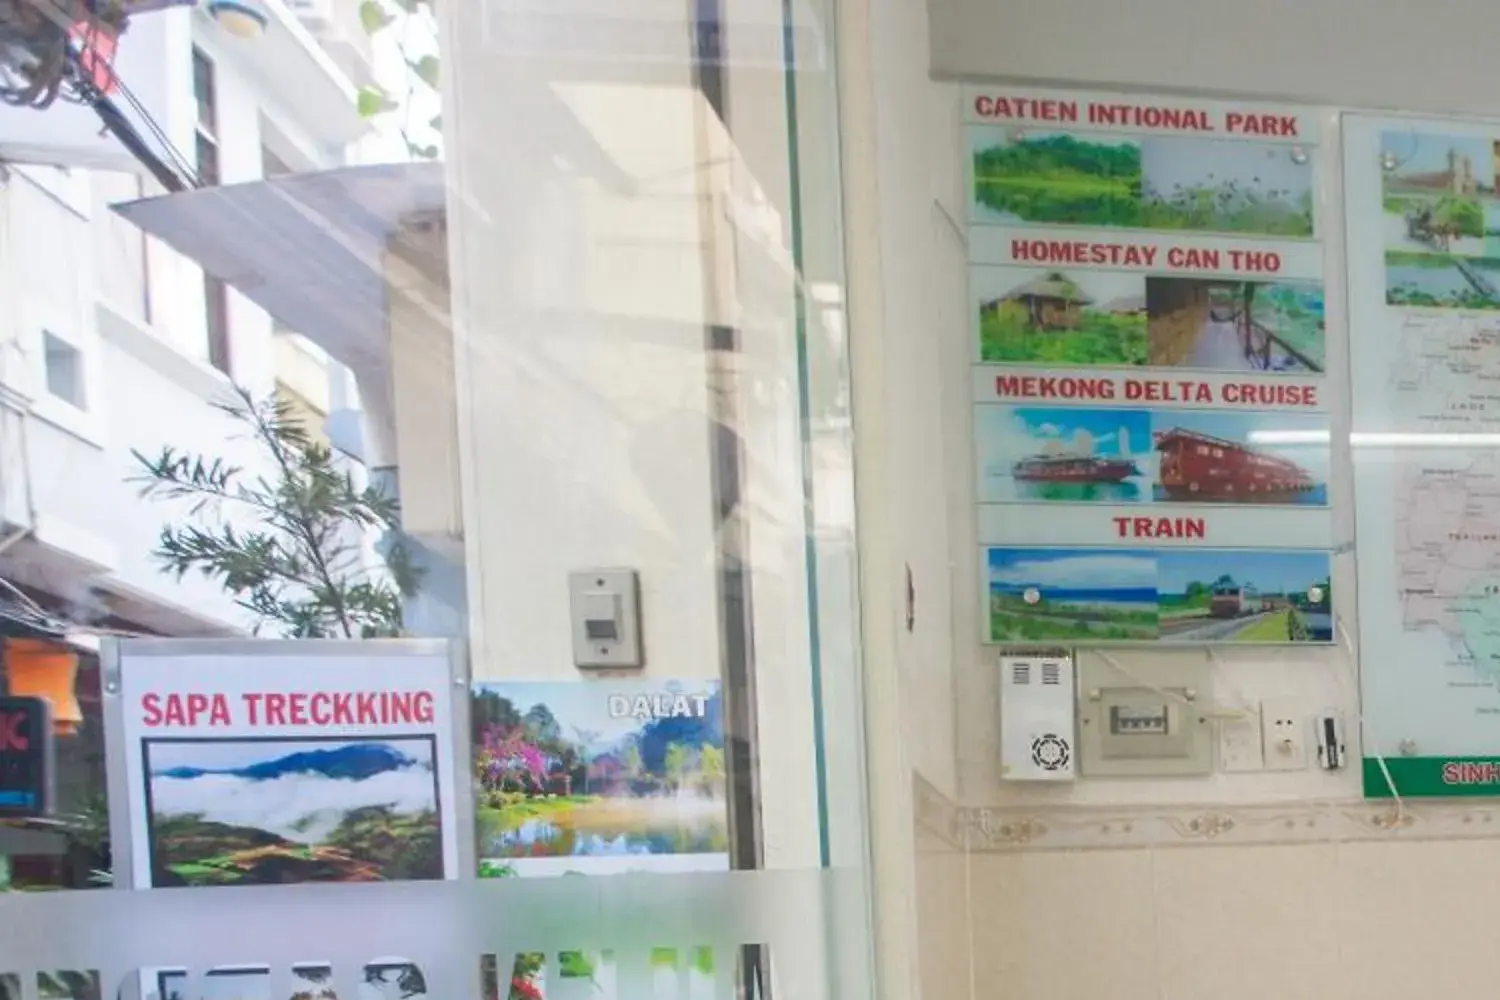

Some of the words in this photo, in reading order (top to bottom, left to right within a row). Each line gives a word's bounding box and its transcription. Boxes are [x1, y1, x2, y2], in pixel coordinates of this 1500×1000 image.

[974, 94, 1078, 123] CATIEN
[1088, 105, 1214, 131] INTIONAL
[1226, 112, 1298, 136] PARK
[1011, 239, 1157, 267] HOMESTAY
[1168, 247, 1219, 270] CAN
[1228, 250, 1281, 272] THO
[996, 375, 1116, 400] MEKONG
[1125, 380, 1213, 402] DELTA
[1222, 383, 1318, 406] CRUISE
[1113, 517, 1206, 538] TRAIN
[141, 691, 232, 728] SAPA
[243, 690, 435, 727] TRECKKING
[609, 693, 707, 719] DALAT
